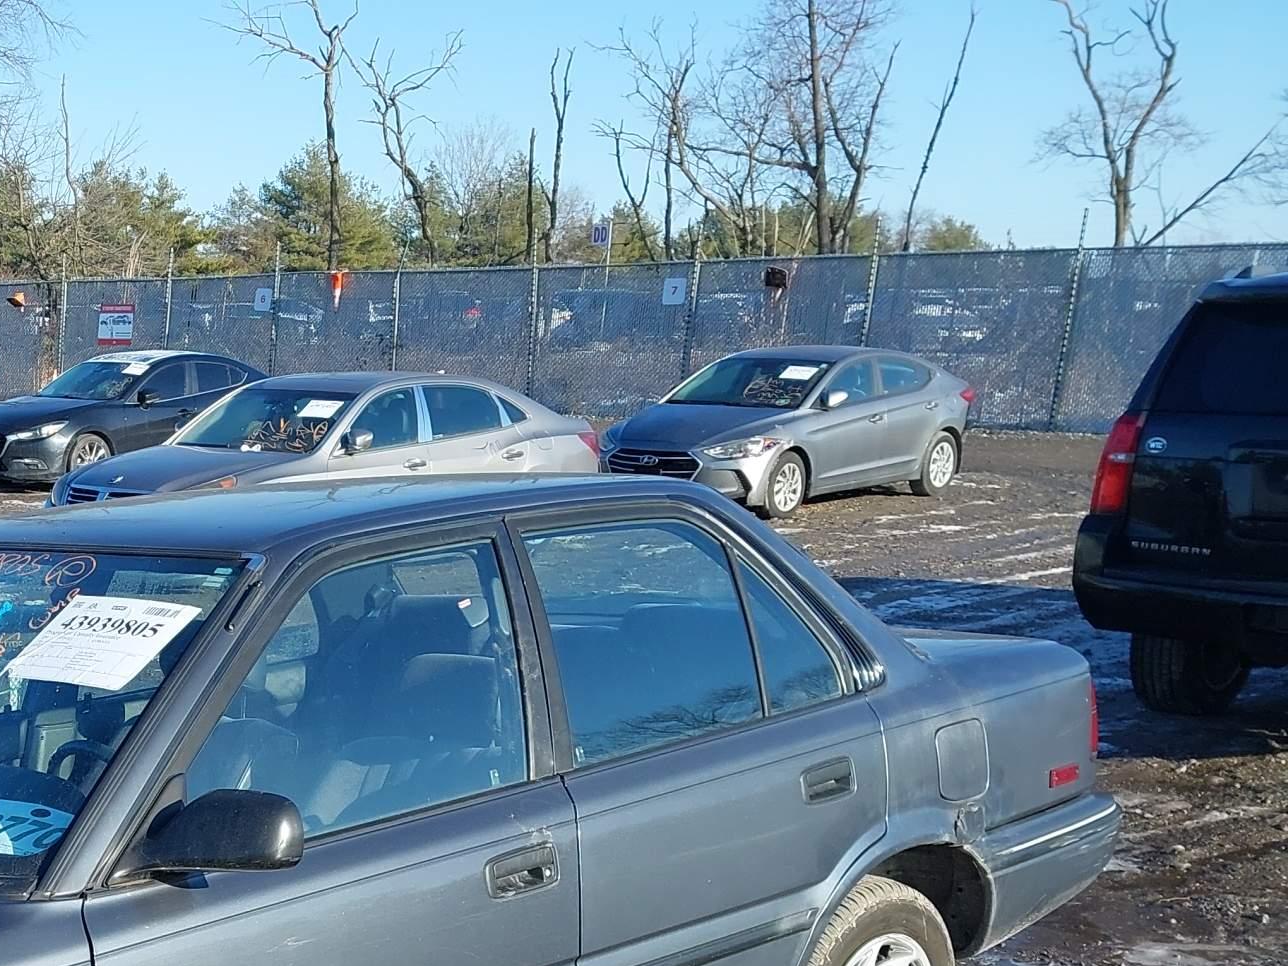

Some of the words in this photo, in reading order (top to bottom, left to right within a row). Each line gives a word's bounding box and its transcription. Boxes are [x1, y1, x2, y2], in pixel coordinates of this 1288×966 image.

[593, 226, 608, 243] DD
[671, 286, 678, 296] 7
[1130, 540, 1212, 556] SUBURBAN
[60, 614, 166, 639] 43939805
